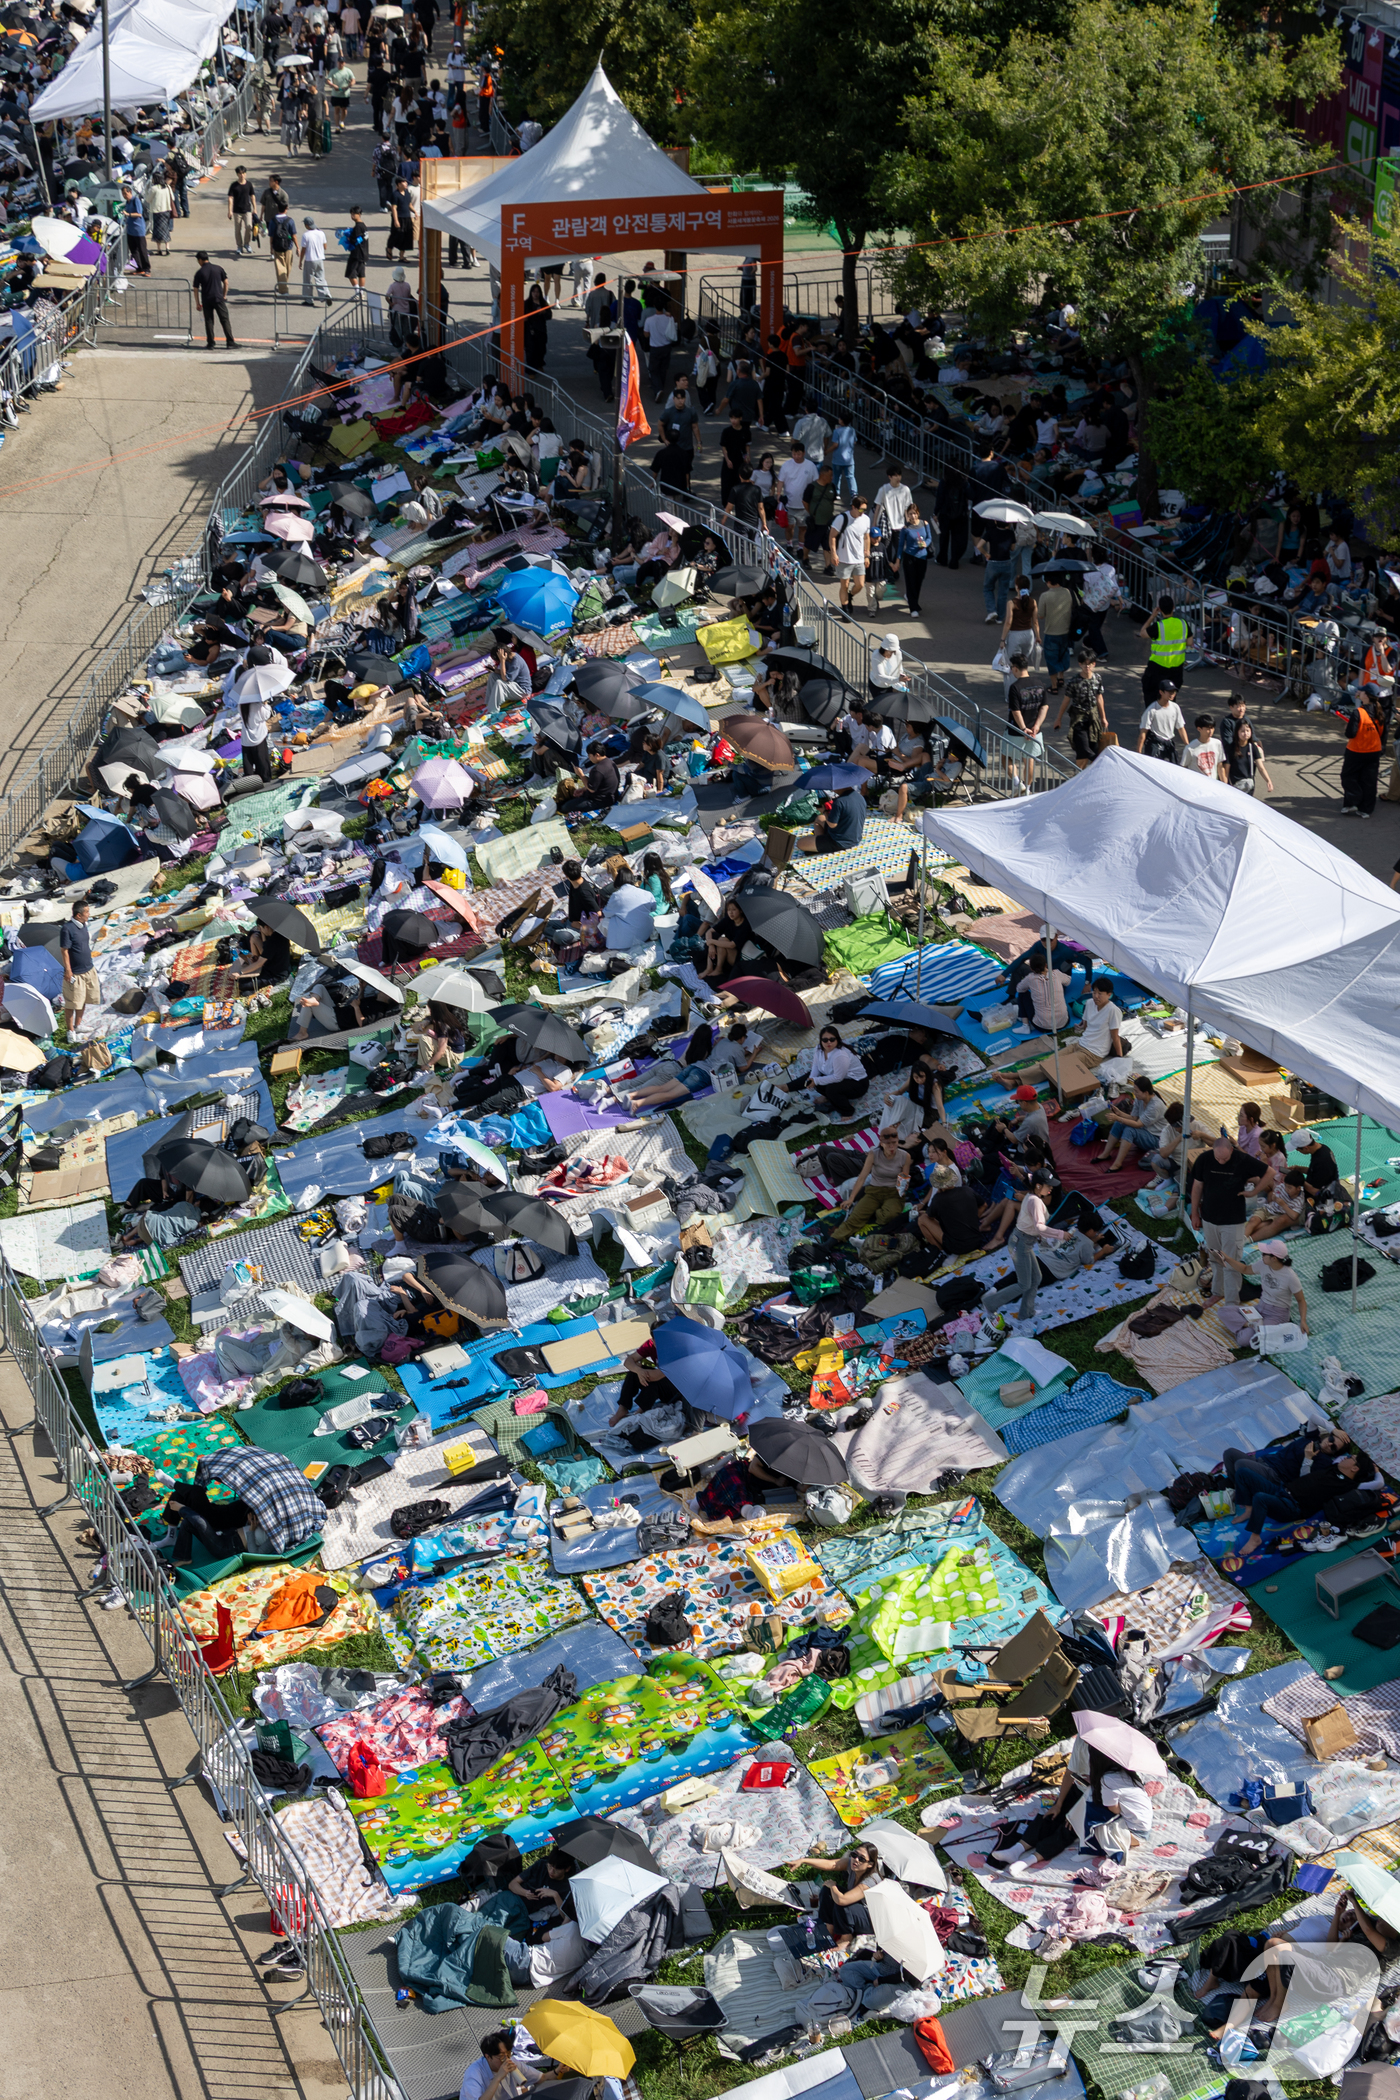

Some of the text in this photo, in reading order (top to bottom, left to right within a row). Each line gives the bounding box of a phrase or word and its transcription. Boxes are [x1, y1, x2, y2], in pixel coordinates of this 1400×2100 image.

[1351, 32, 1365, 63] CU
[1348, 75, 1379, 122] WITH
[1347, 120, 1375, 176] CU
[512, 214, 526, 234] F
[551, 209, 722, 238] 관람객 안전통제구역
[505, 236, 533, 252] 구역
[550, 620, 566, 629] ecco
[981, 1324, 1002, 1342] NIKE
